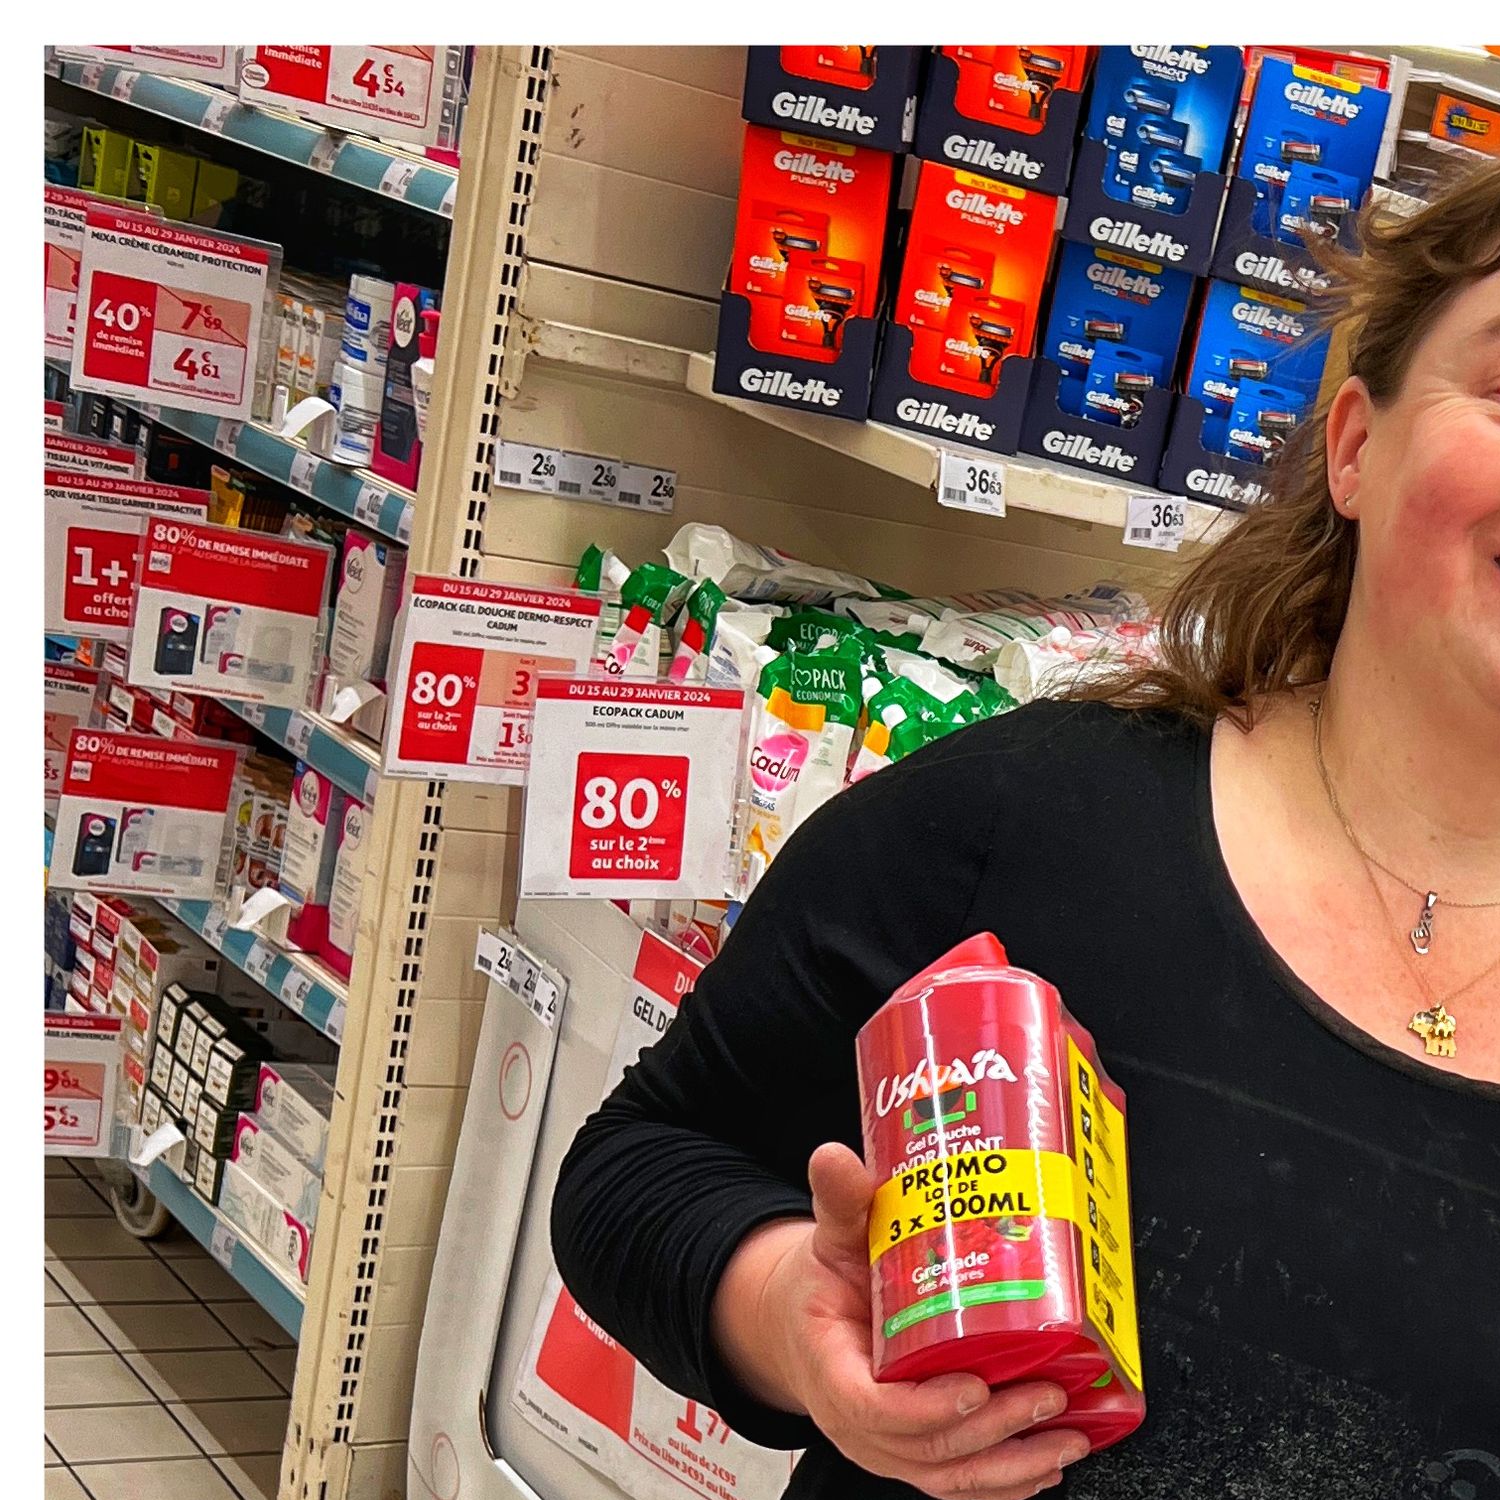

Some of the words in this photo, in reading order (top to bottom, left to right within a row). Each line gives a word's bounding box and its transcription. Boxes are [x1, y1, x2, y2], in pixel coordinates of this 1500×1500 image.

[264, 49, 322, 69] immédiate
[772, 92, 878, 135] Gillette
[1284, 81, 1361, 119] Gillette
[774, 150, 855, 184] Gillette
[116, 219, 129, 228] DU
[132, 223, 143, 232] 15
[145, 226, 159, 235] AU
[161, 230, 173, 239] 29
[174, 232, 214, 249] JANVIER
[216, 242, 240, 254] 2024
[1089, 217, 1189, 261] Gillette
[91, 232, 116, 243] MIXA
[119, 236, 150, 250] CRÈME
[152, 243, 200, 262] CÉRAMIDE
[202, 255, 262, 275] PROTECTION
[1087, 263, 1164, 300] Gillette
[96, 330, 108, 338] de
[110, 334, 143, 346] remise
[740, 368, 842, 406] Gillette
[897, 398, 995, 441] Gillette
[67, 490, 96, 502] VISAGE
[98, 494, 121, 505] TISSU
[122, 496, 155, 509] GARNIER
[157, 502, 202, 516] SKINACTIVE
[153, 524, 196, 547] 80%
[198, 538, 211, 550] DE
[213, 541, 250, 558] REMISE
[252, 547, 310, 569] IMMÉDIATE
[414, 596, 458, 612] ÉCOPACK
[460, 603, 476, 615] GEL
[478, 605, 516, 619] DOUCHE
[518, 610, 592, 628] DERMO-RESPECT
[443, 583, 456, 594] DU
[460, 586, 471, 597] 15
[473, 588, 487, 599] AU
[489, 589, 501, 601] 29
[503, 591, 544, 605] JANVIER
[546, 596, 571, 608] 2024
[487, 619, 518, 632] CADUM
[418, 720, 430, 729] au
[432, 721, 458, 731] choix
[76, 735, 115, 754] 80%
[116, 746, 129, 756] DE
[130, 747, 164, 762] REMISE
[166, 752, 218, 768] IMMÉDIATE
[750, 746, 800, 782] Cadum
[580, 776, 681, 829] 80%
[590, 838, 614, 851] sur
[619, 837, 634, 851] le
[592, 857, 612, 870] au
[615, 855, 659, 870] choix
[906, 1139, 926, 1156] Gel
[925, 1184, 954, 1204] LOT
[957, 1178, 979, 1194] DE
[889, 1219, 902, 1242] 3
[933, 1191, 1030, 1224] 300ML
[668, 1437, 682, 1449] au
[681, 1441, 698, 1459] lieu
[699, 1456, 711, 1469] de
